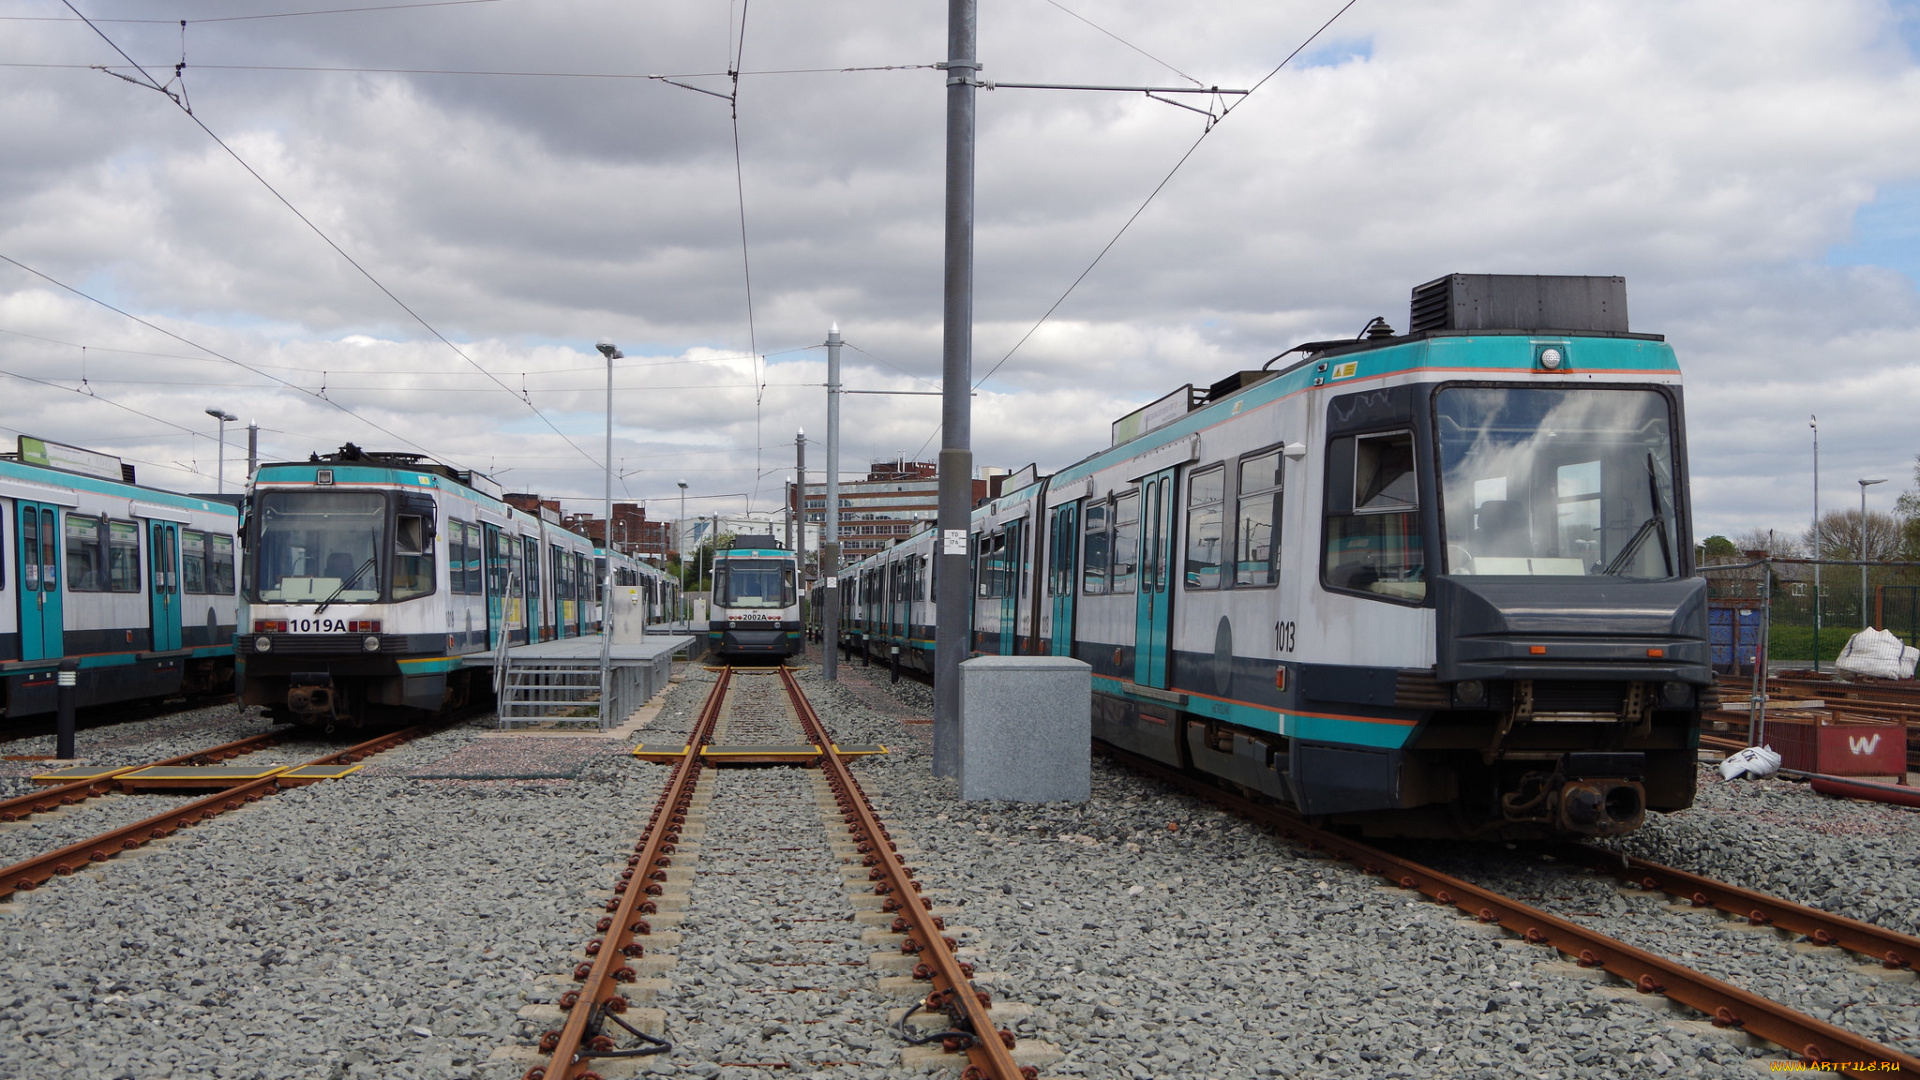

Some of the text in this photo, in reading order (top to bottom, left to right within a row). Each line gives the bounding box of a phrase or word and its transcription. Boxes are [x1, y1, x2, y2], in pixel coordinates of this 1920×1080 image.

[290, 619, 347, 633] 1019A
[742, 613, 767, 621] 2002A
[1275, 621, 1295, 652] 1013
[1849, 733, 1879, 755] W
